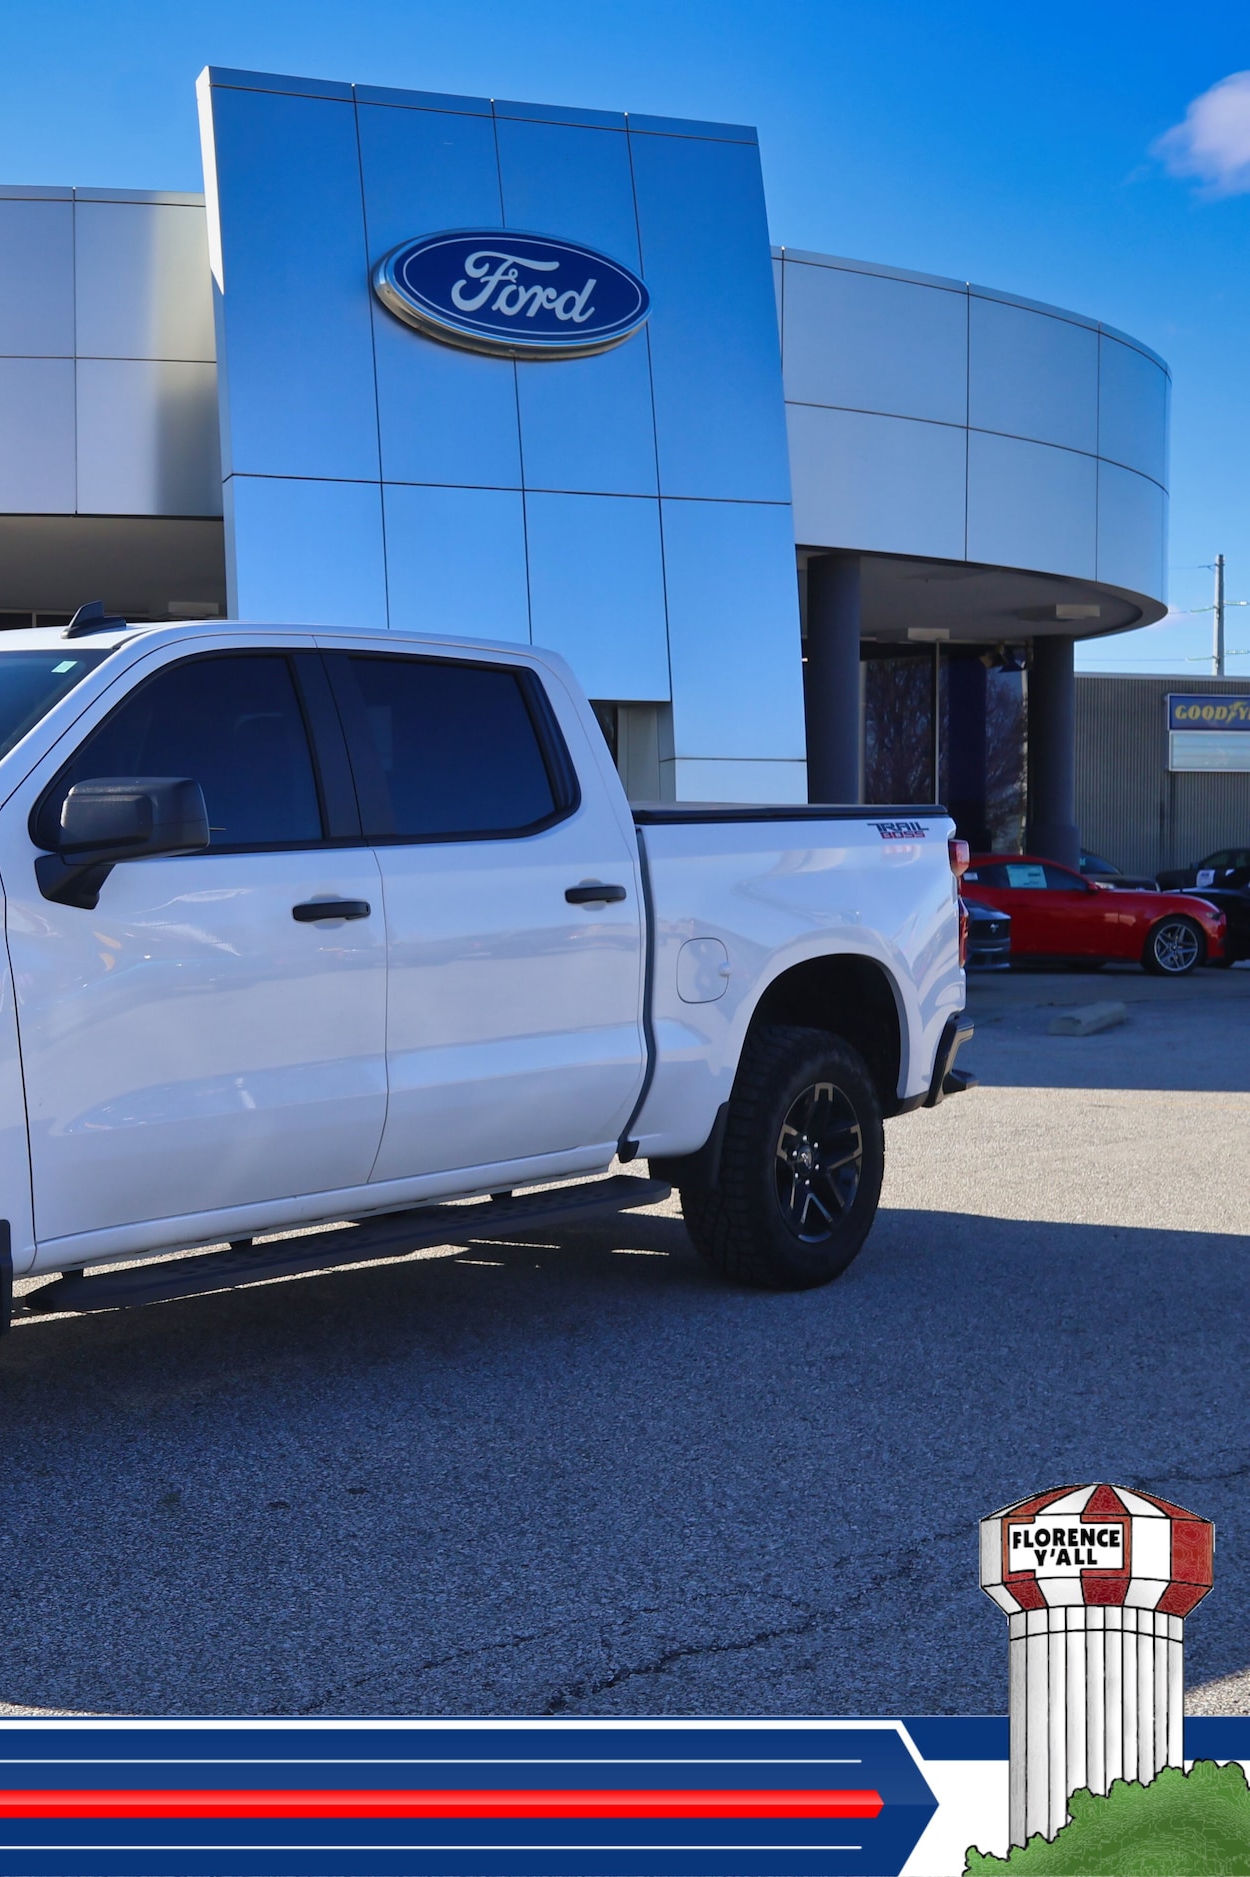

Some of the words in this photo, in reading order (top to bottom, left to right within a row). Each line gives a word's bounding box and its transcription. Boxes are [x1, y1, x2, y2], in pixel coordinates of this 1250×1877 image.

[451, 251, 597, 323] Ford
[1175, 702, 1250, 723] GOODY
[867, 822, 930, 832] TRAIL
[881, 831, 926, 839] BOSS
